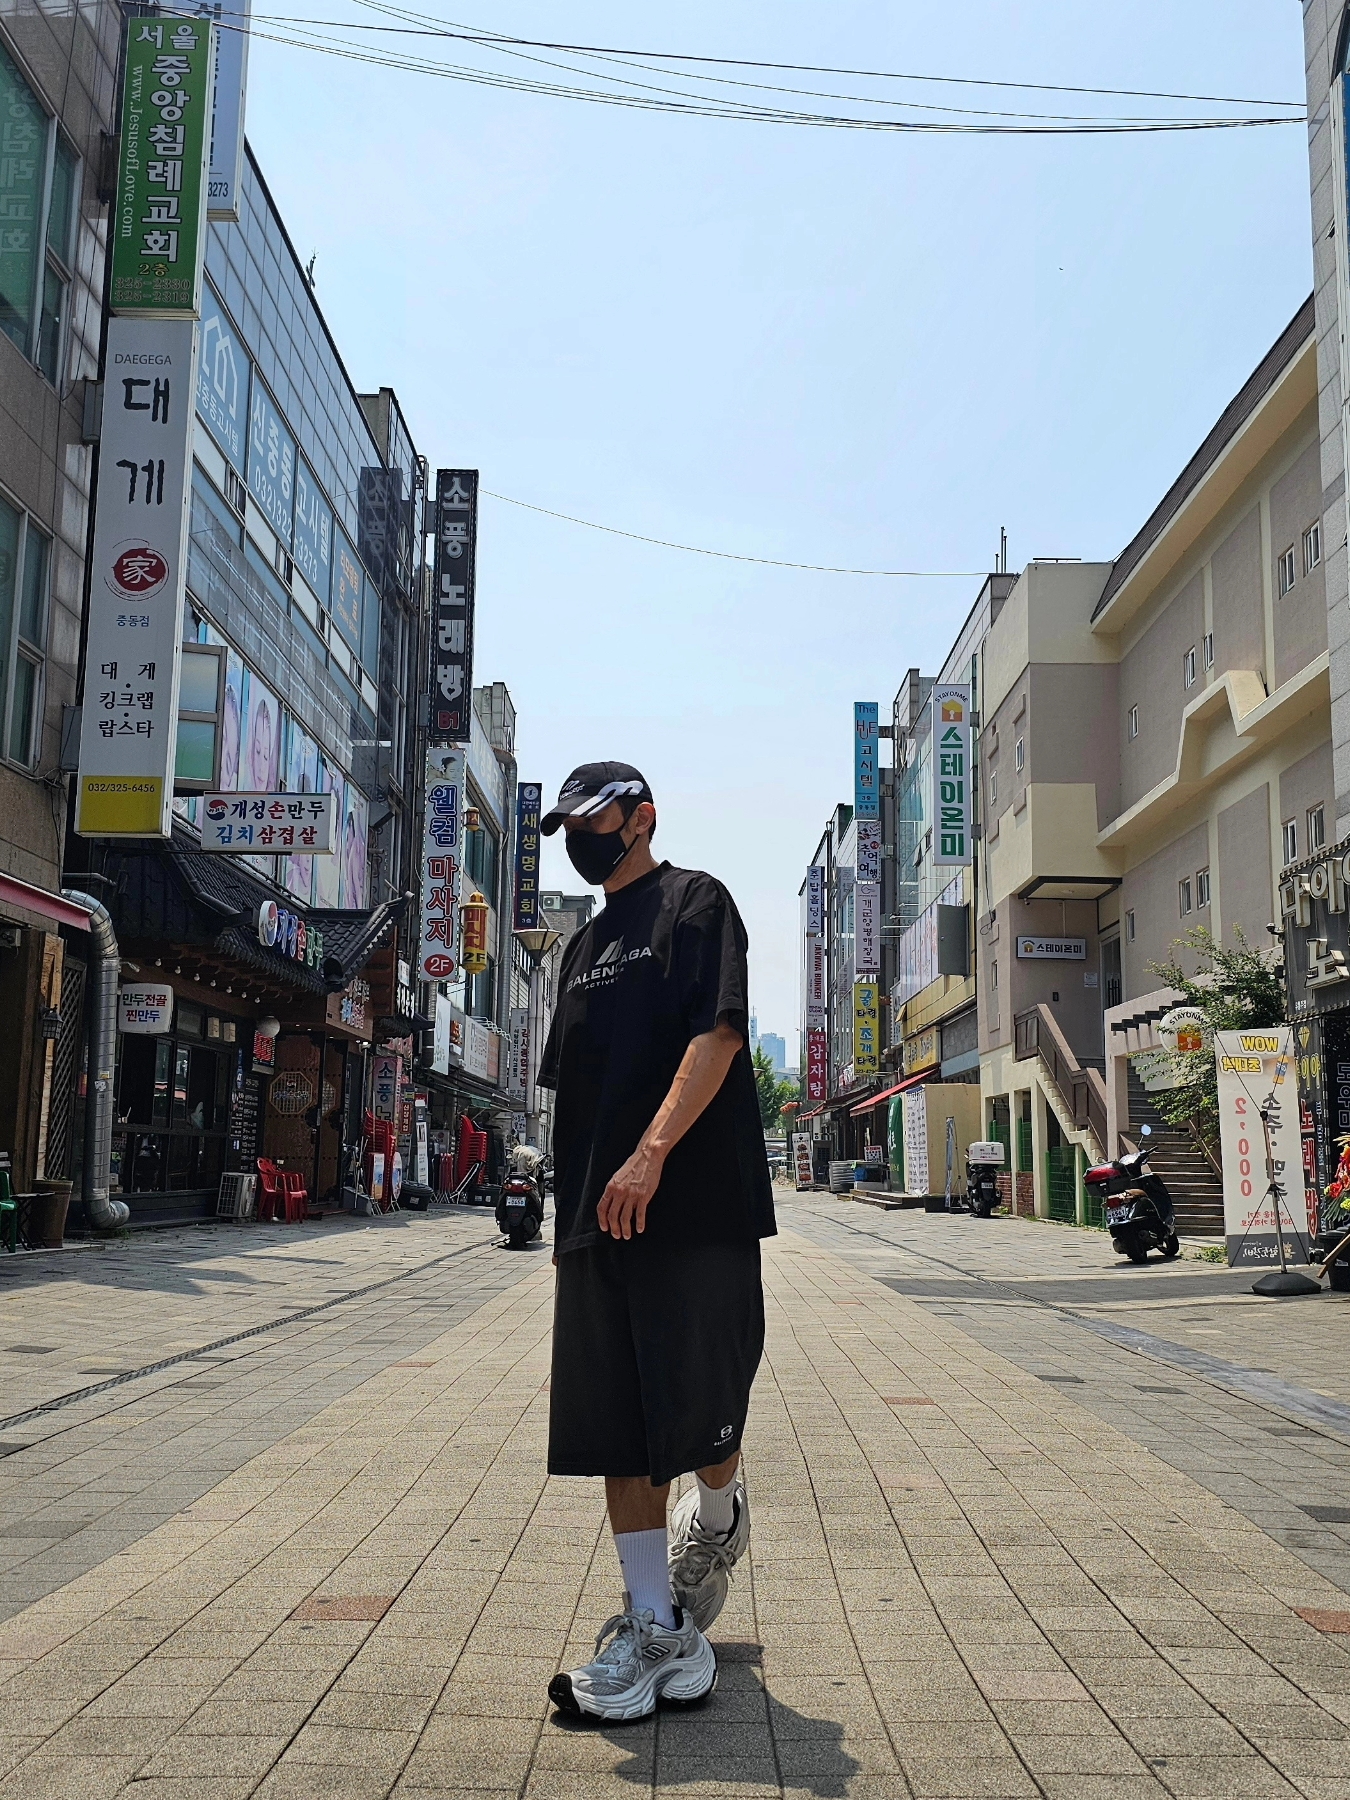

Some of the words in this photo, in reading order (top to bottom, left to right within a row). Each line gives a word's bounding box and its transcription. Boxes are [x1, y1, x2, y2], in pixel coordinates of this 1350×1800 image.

[135, 24, 200, 50] 서울
[121, 64, 144, 238] www.JesusofLove.com
[140, 54, 192, 263] 중앙침례교회
[139, 263, 169, 277] 2층
[114, 353, 173, 366] DAEGEGA
[122, 555, 157, 585] 家
[116, 614, 151, 628] 중동점
[99, 691, 155, 710] 킹크랩
[857, 704, 876, 714] The
[99, 719, 155, 739] 랍스타
[437, 709, 461, 731] B1
[860, 745, 873, 788] 고시텔
[87, 783, 156, 793] 032/325-6456
[939, 726, 965, 857] 스테이온미
[230, 799, 326, 820] 개성손만두
[429, 784, 458, 847] 웰컴
[215, 824, 319, 846] 김치삼겹살
[519, 812, 538, 915] 새생명교회
[427, 855, 459, 948] 마사지
[463, 951, 486, 962] 2F
[1036, 943, 1082, 954] 스테이온미
[429, 957, 450, 972] 2F
[566, 946, 653, 994] BALENCAGA
[121, 993, 168, 1008] 만두전골
[125, 1010, 161, 1023] 찐만두
[809, 1043, 824, 1097] 감자탕
